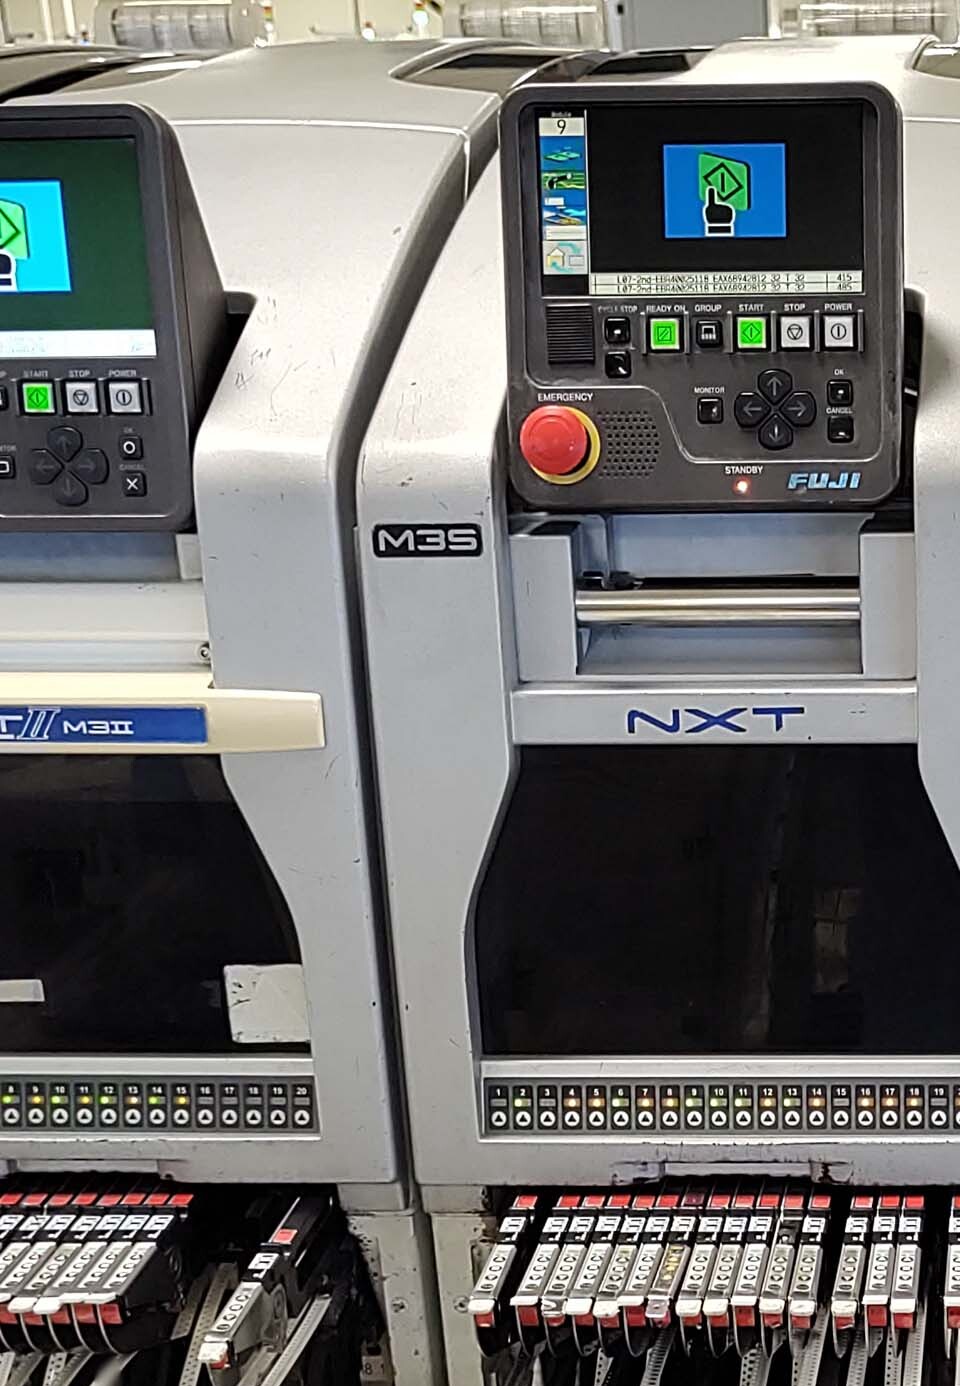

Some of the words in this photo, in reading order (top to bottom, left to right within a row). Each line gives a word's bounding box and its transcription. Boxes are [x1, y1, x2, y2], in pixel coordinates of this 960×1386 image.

[557, 119, 567, 135] 9
[646, 304, 672, 313] READY
[673, 304, 686, 313] ON
[694, 304, 722, 312] GROUP
[738, 304, 764, 312] START
[784, 303, 806, 311] STOP
[825, 303, 853, 311] POWER
[537, 392, 594, 402] EMERGENCY
[725, 466, 763, 475] STANDBY
[787, 472, 861, 489] FUJI
[379, 529, 477, 551] M3S
[627, 707, 805, 734] NXT
